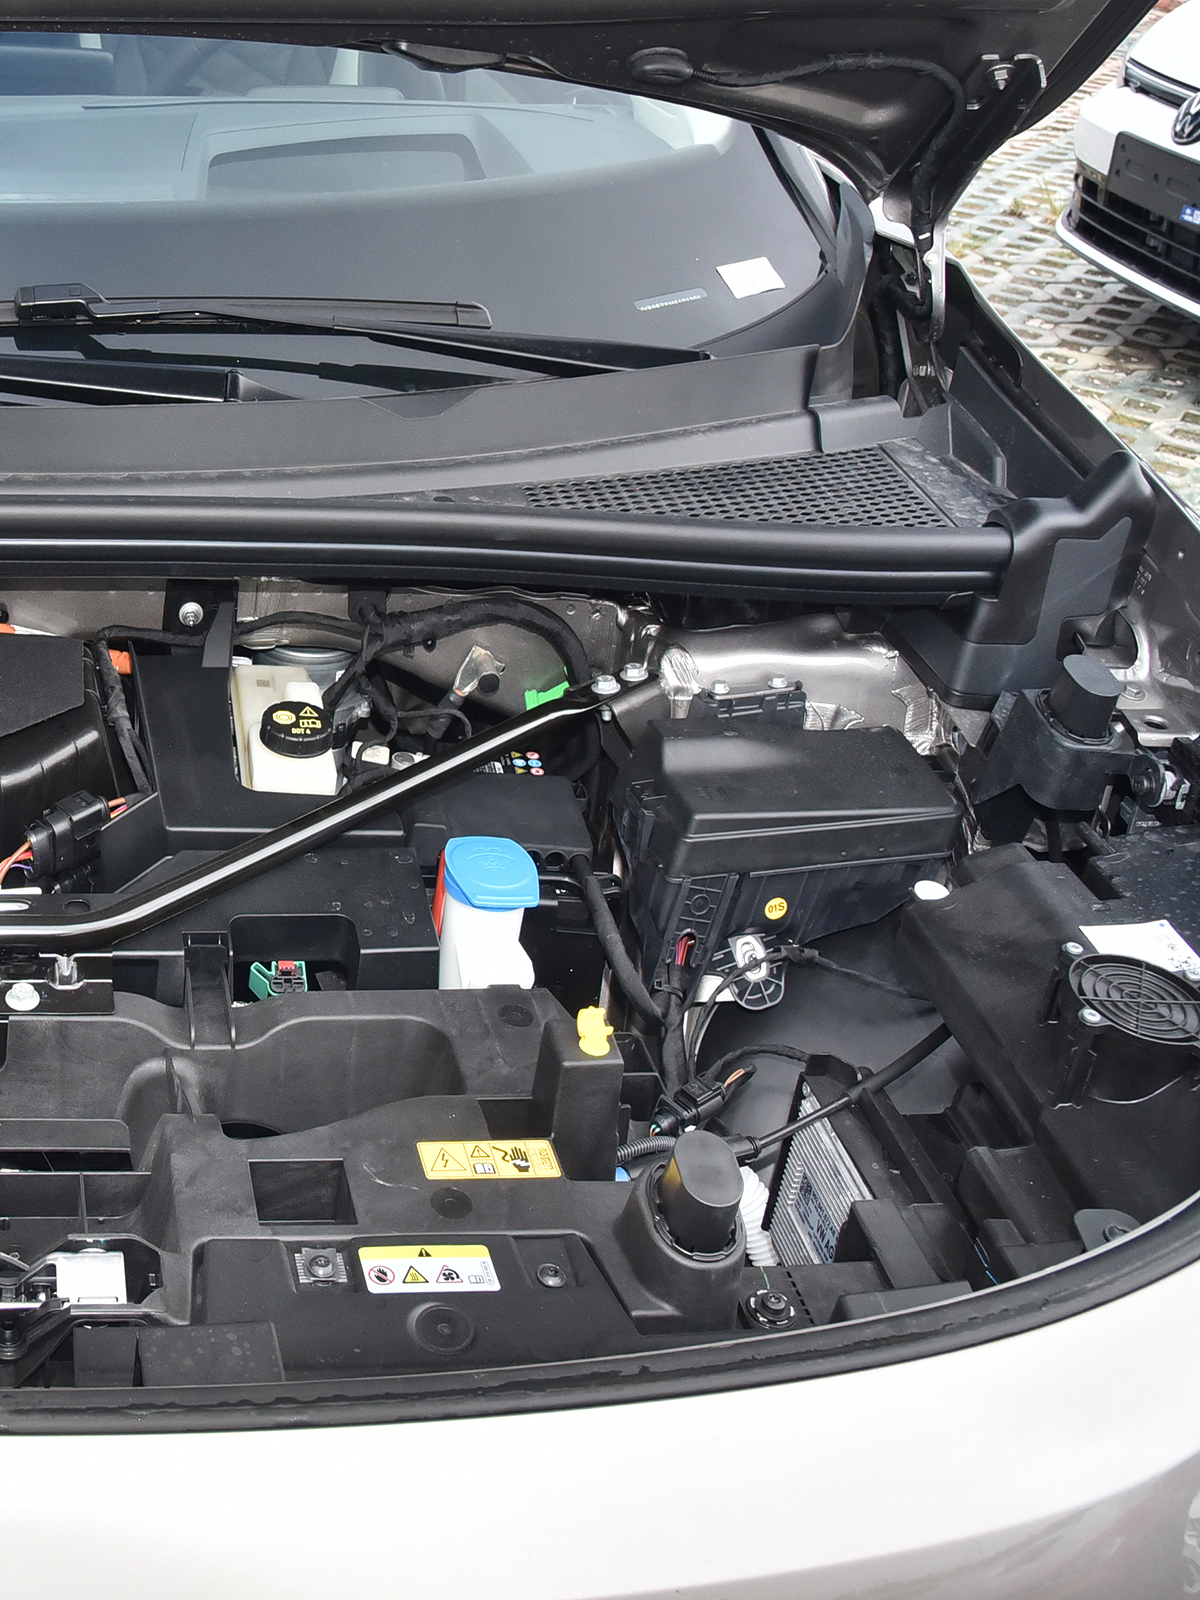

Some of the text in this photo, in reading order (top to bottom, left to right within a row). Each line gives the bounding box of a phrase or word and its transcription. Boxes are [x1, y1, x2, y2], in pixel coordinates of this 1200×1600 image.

[291, 727, 305, 735] DOT
[767, 901, 785, 914] 01S
[824, 1239, 835, 1260] AG
